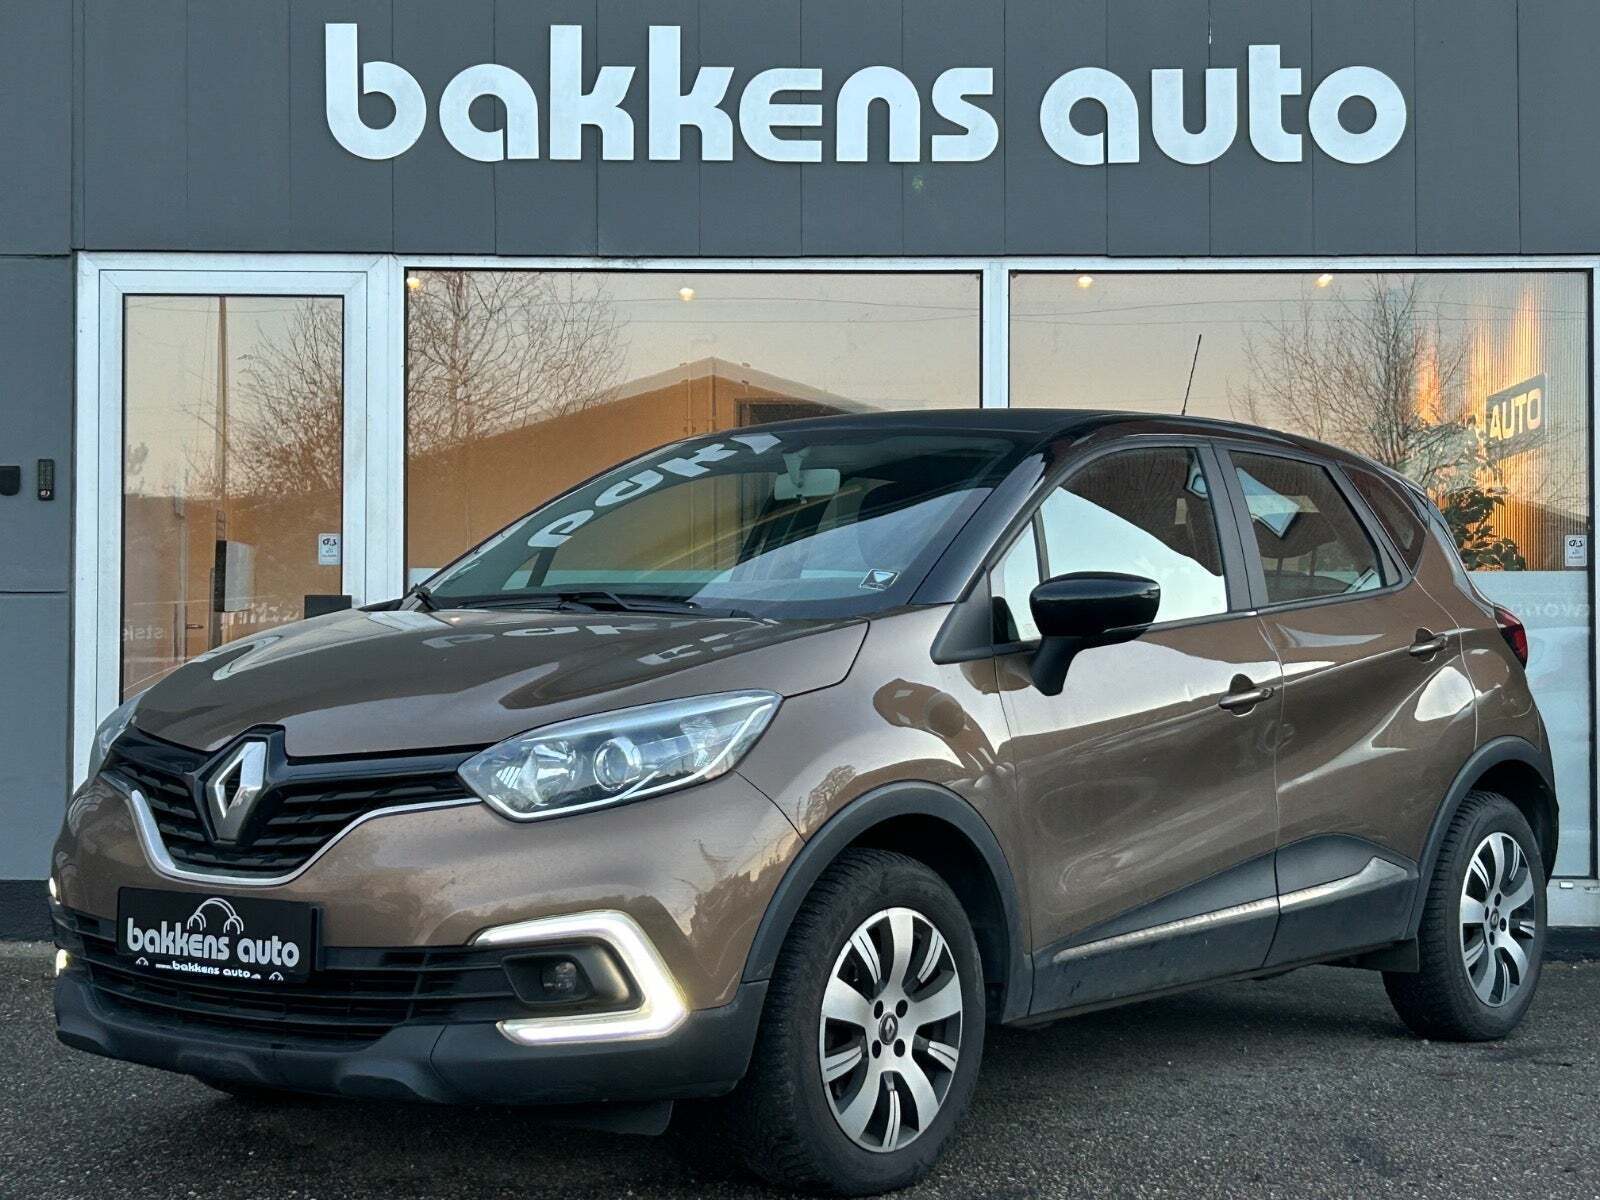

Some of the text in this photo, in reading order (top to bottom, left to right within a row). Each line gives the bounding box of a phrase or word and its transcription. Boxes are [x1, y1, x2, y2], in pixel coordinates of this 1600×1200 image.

[325, 23, 1408, 165] bakkens auto
[1489, 387, 1541, 441] AUTO
[126, 917, 300, 968] bakkens auto
